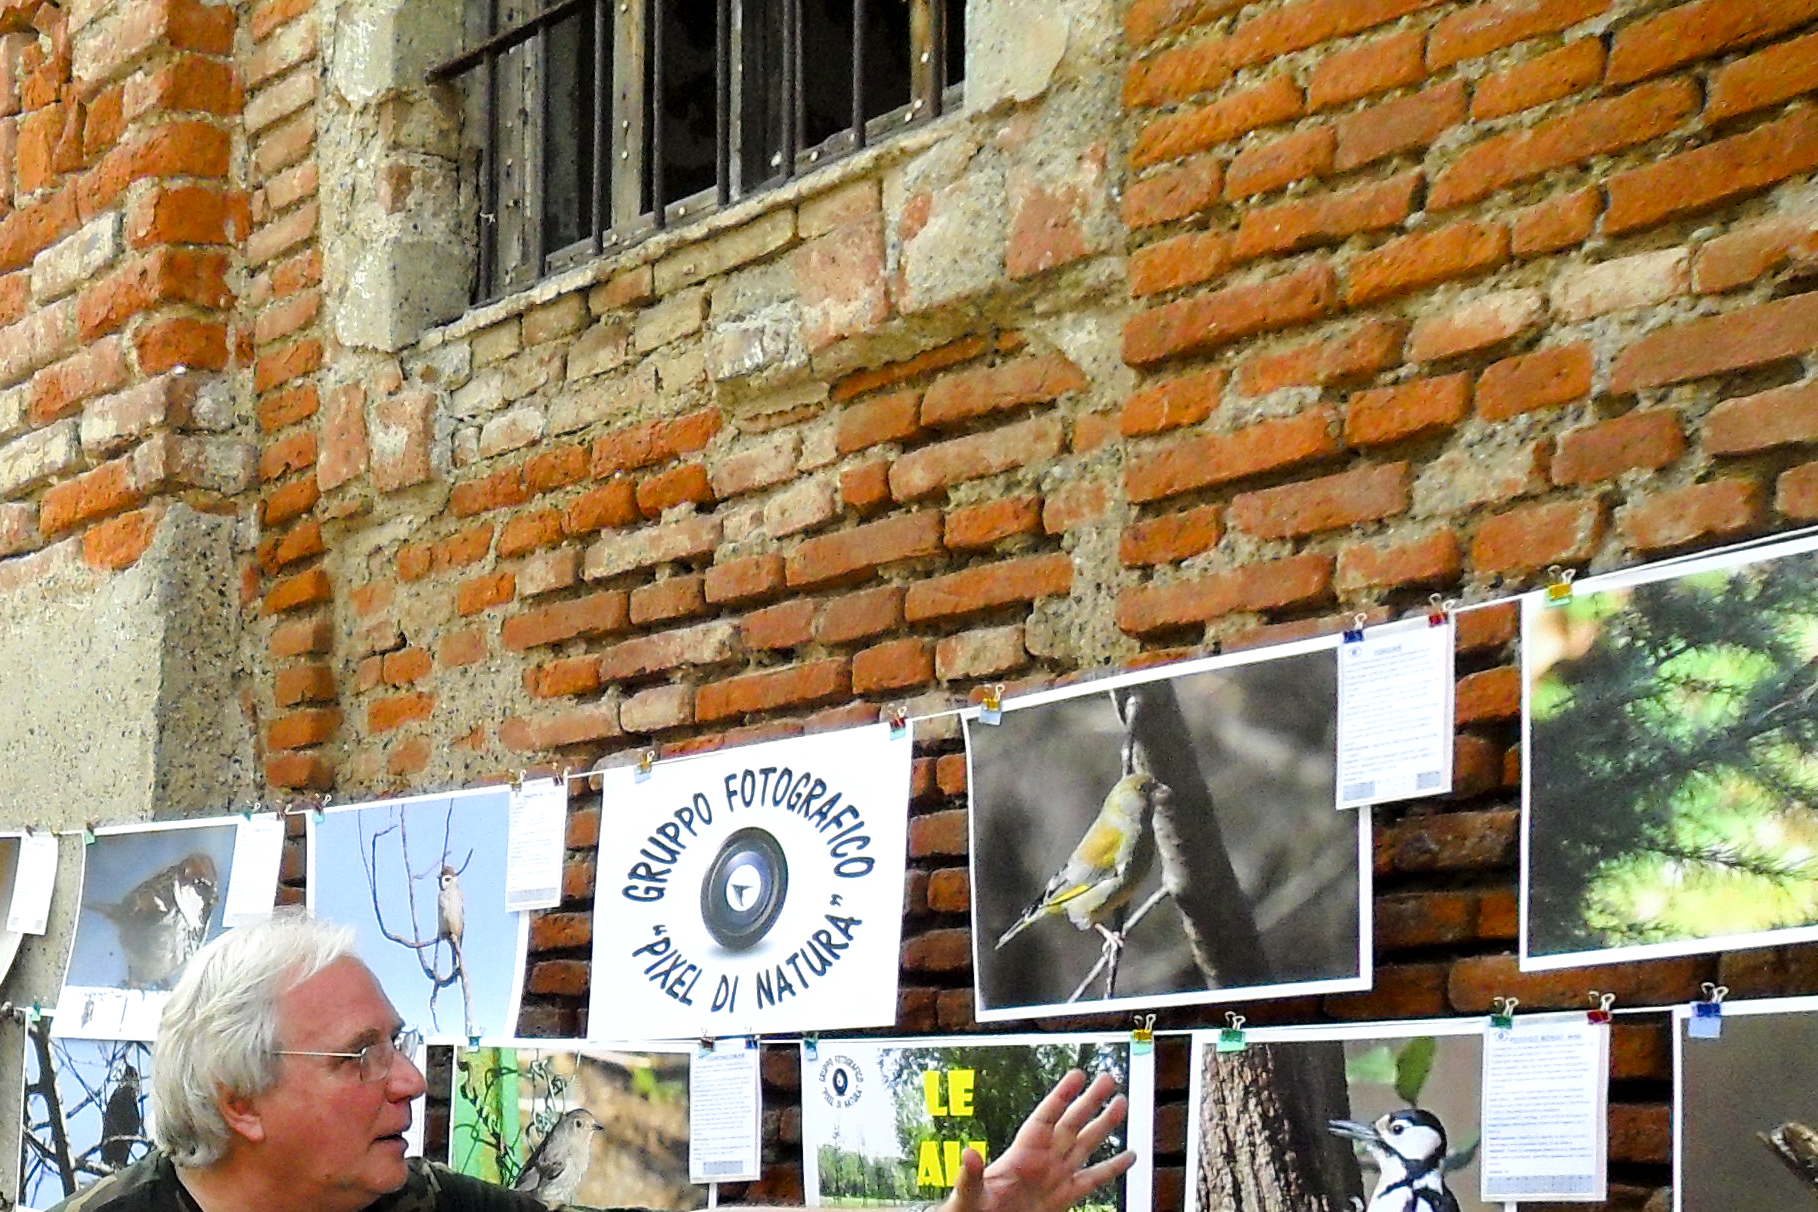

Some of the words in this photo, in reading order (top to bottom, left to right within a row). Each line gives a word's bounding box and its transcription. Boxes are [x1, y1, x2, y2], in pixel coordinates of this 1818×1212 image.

[622, 792, 713, 902] GRUPPO
[724, 766, 875, 878] FOTOGRAFICO
[632, 924, 703, 1006] "PIXEL
[711, 974, 738, 1013] DI
[756, 894, 862, 1010] NATURA"
[923, 1069, 976, 1117] LE
